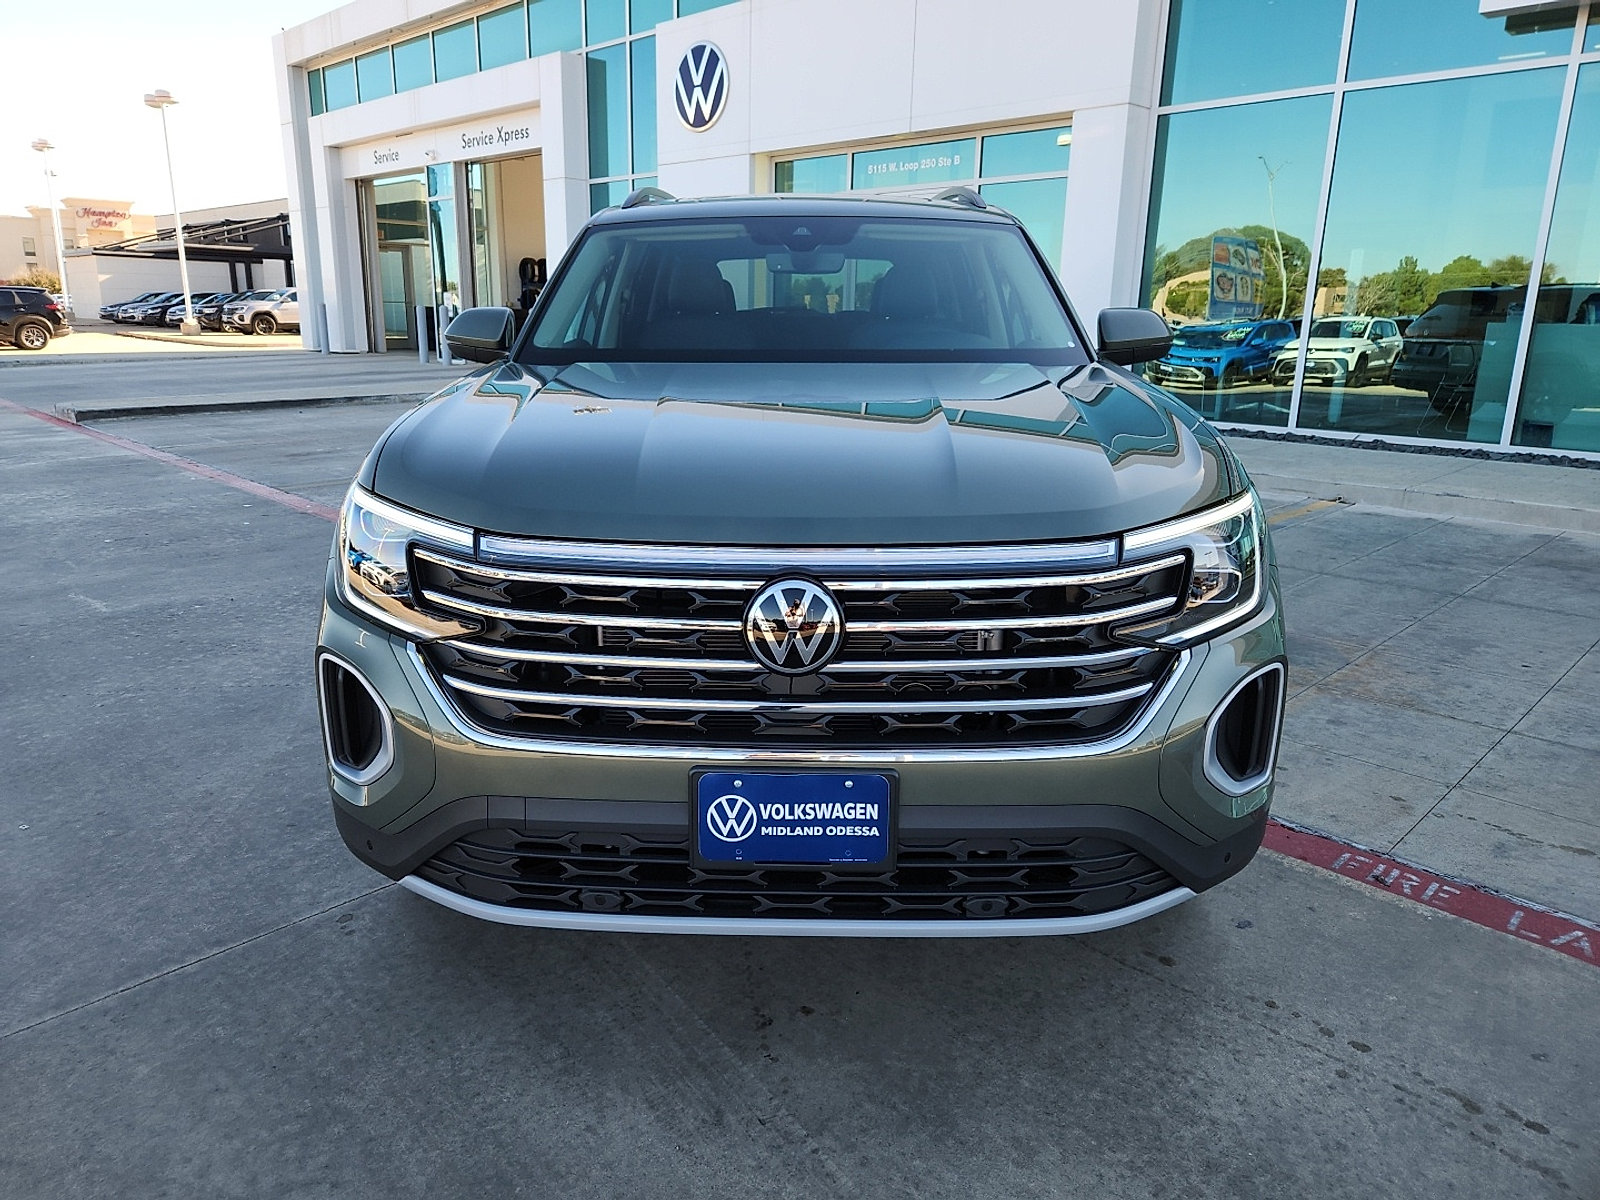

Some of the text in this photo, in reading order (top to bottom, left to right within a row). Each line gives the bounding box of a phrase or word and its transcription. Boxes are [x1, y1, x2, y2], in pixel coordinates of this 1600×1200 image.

[461, 126, 530, 149] Service Xpress
[373, 148, 399, 165] Service
[867, 155, 961, 174] 5115 W. Loop 250 Ste B
[76, 207, 131, 220] Hampton
[91, 218, 117, 228] Inn
[759, 803, 879, 820] VOLKSWAGEN
[761, 826, 880, 837] MIDLAND ODESSA
[1332, 853, 1461, 905] FIRE
